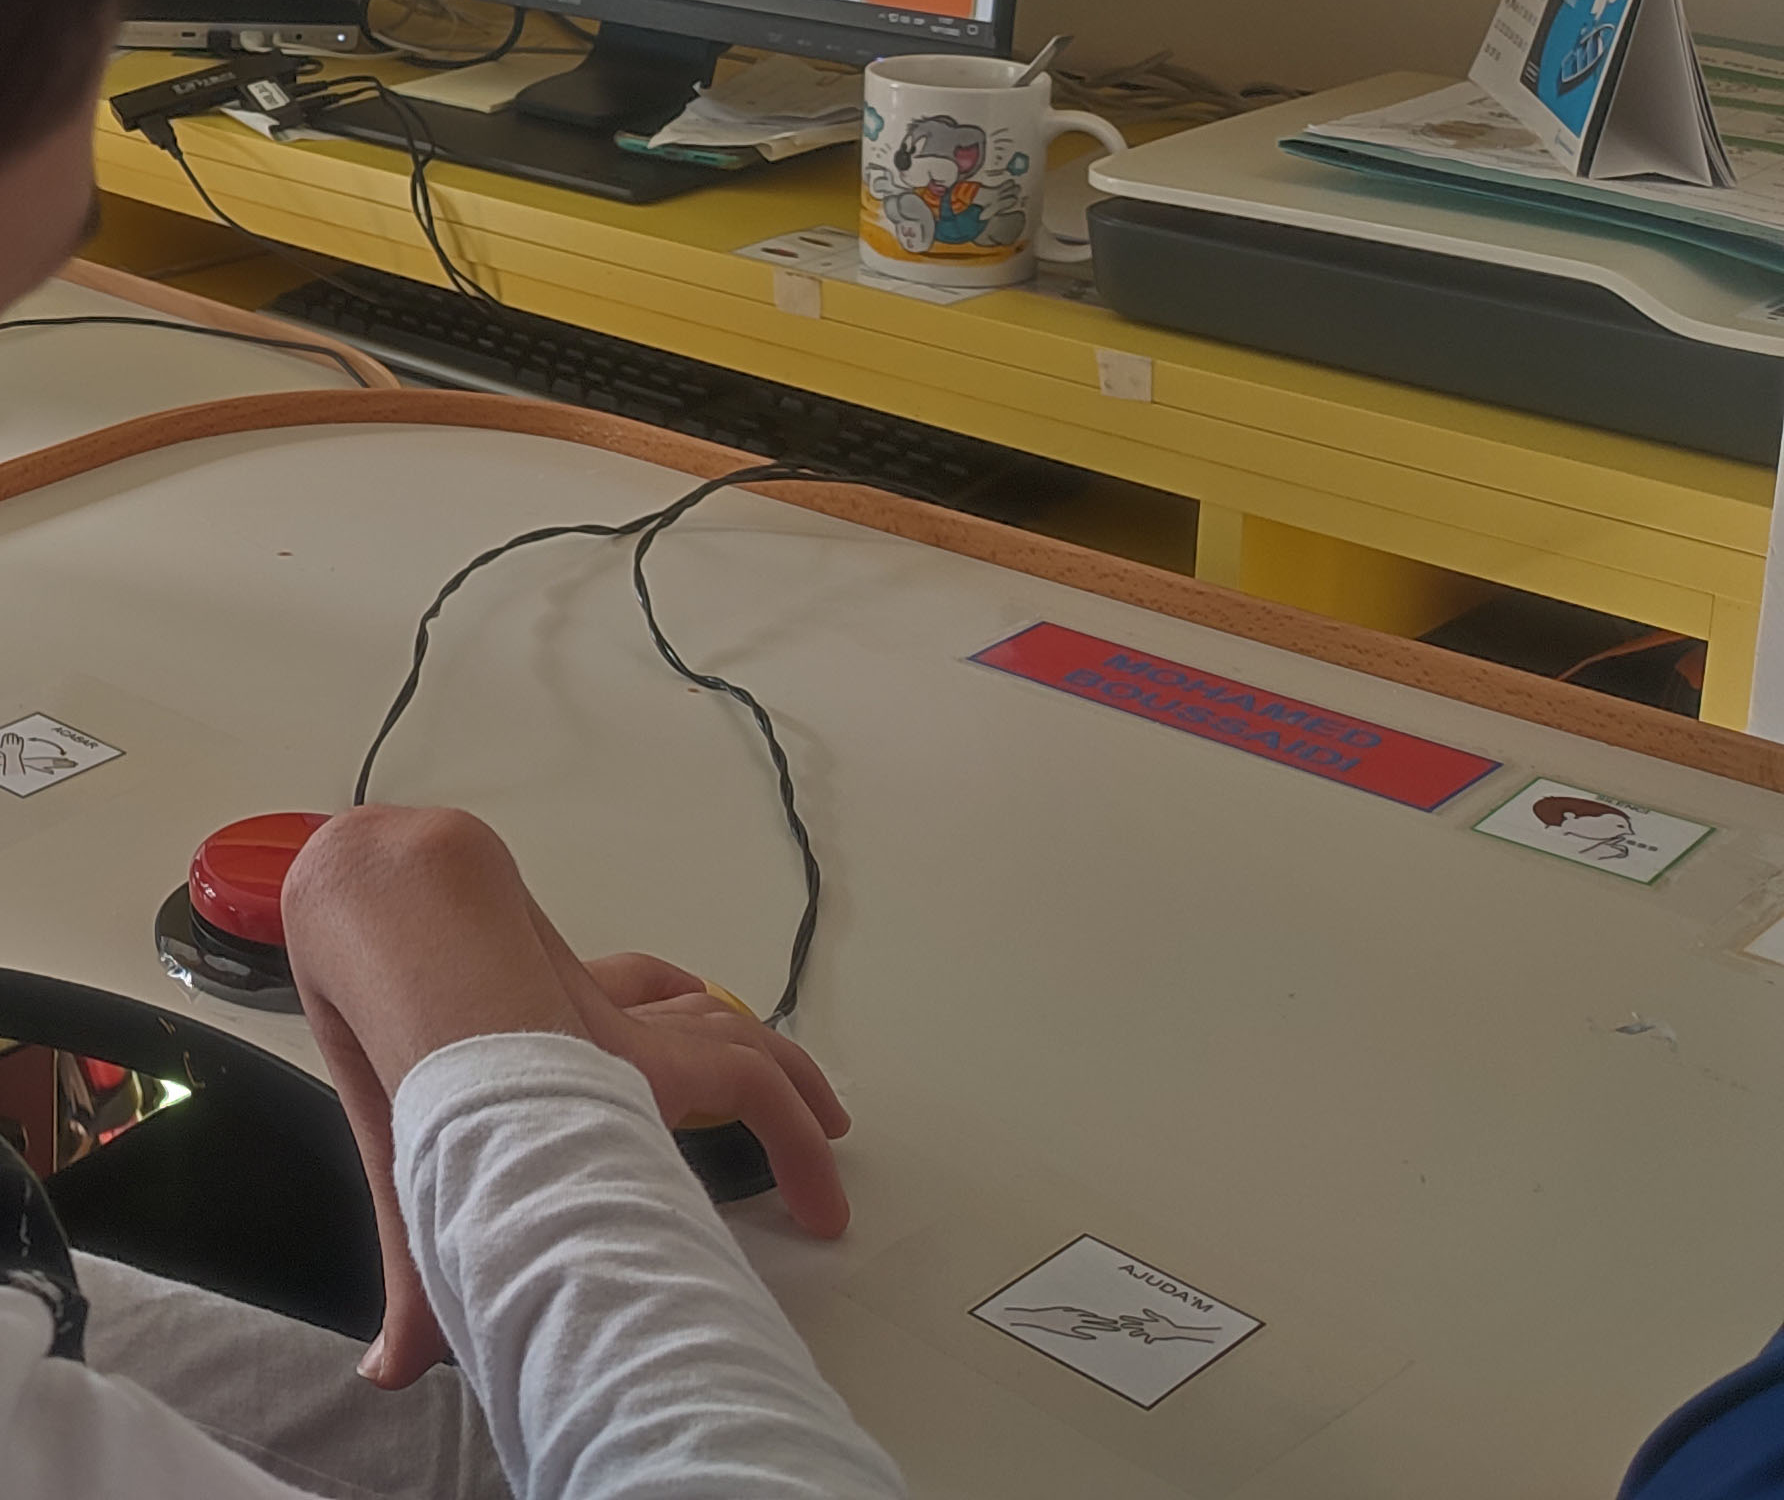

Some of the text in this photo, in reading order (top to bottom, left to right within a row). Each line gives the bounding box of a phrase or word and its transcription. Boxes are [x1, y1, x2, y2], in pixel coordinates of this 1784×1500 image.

[1064, 668, 1362, 773] BOUSSAIDI
[1102, 653, 1383, 749] MOHAMED
[50, 725, 99, 751] ACABAR
[1117, 1263, 1214, 1313] AJUDA'M
